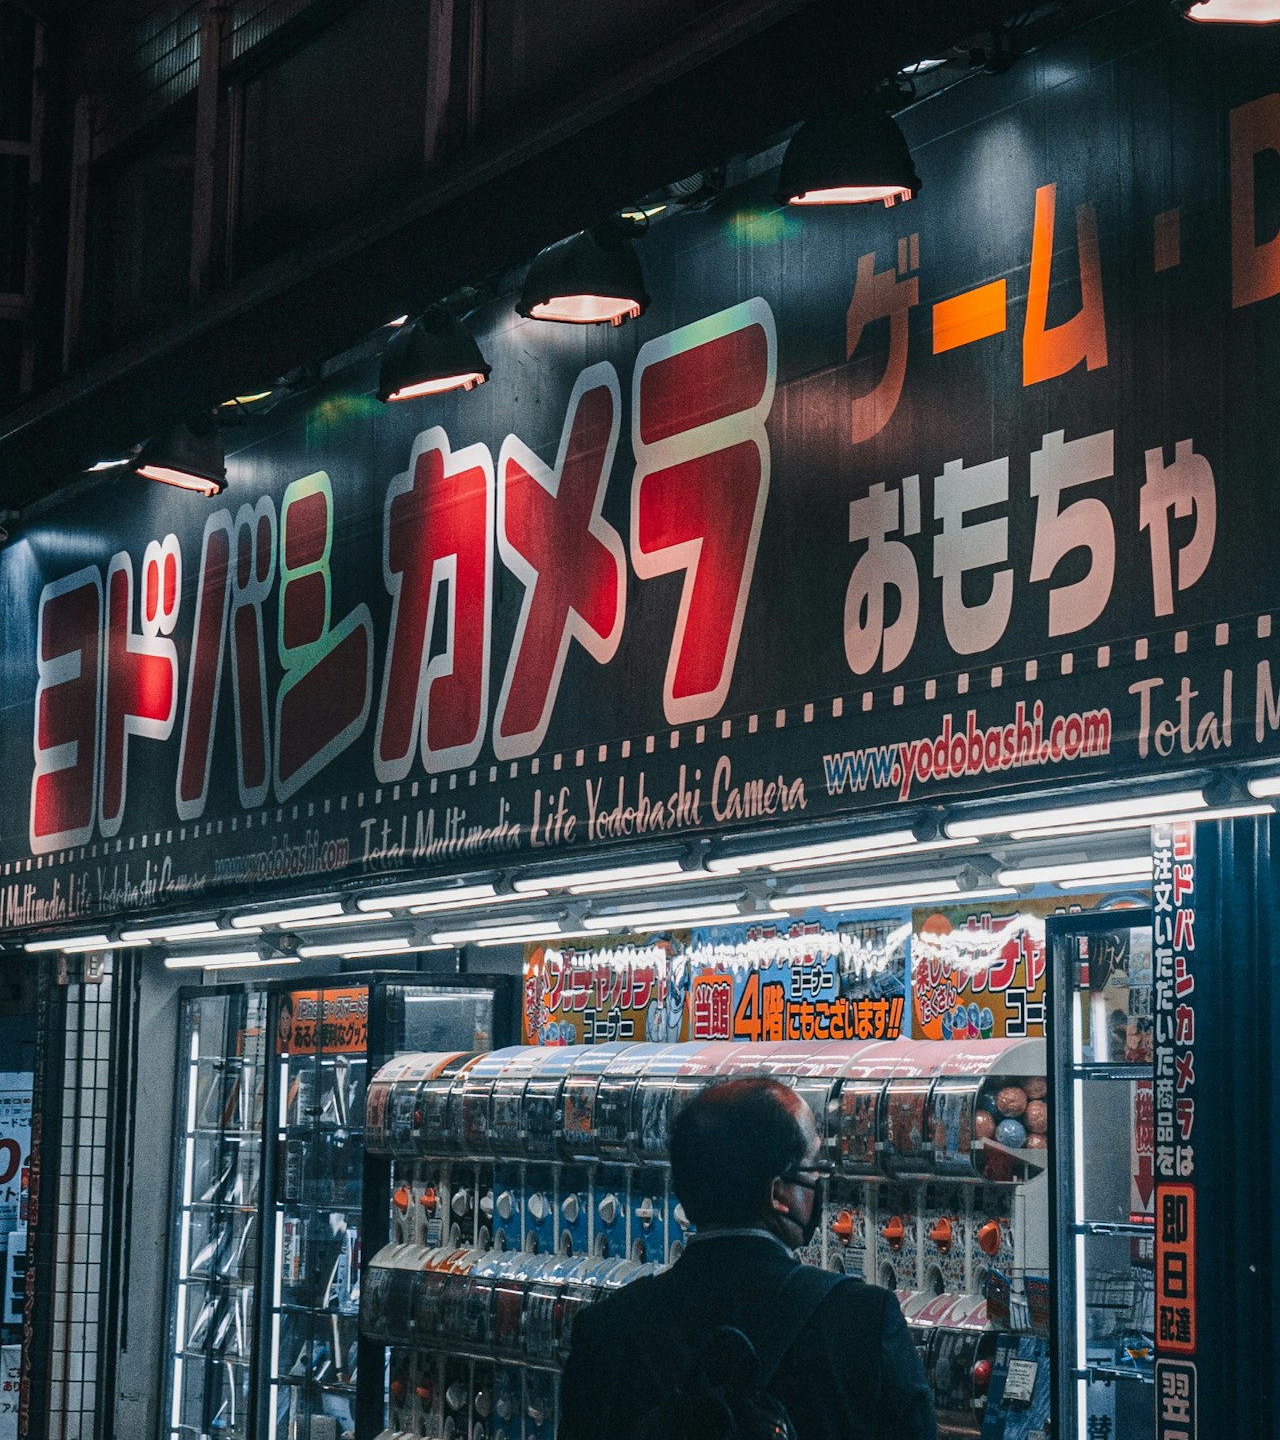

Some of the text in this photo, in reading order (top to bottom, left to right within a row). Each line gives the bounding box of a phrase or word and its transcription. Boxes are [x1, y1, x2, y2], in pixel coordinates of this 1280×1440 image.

[29, 296, 776, 855] ヨドバシカメラ
[823, 703, 1113, 802] www.yodobashi.com
[1128, 669, 1235, 759] Total
[361, 754, 809, 875] Total Multimedia Life Yodobashi Camera
[5, 876, 66, 928] Multimedia
[583, 1006, 635, 1042] コーナー
[694, 983, 730, 1040] 当館
